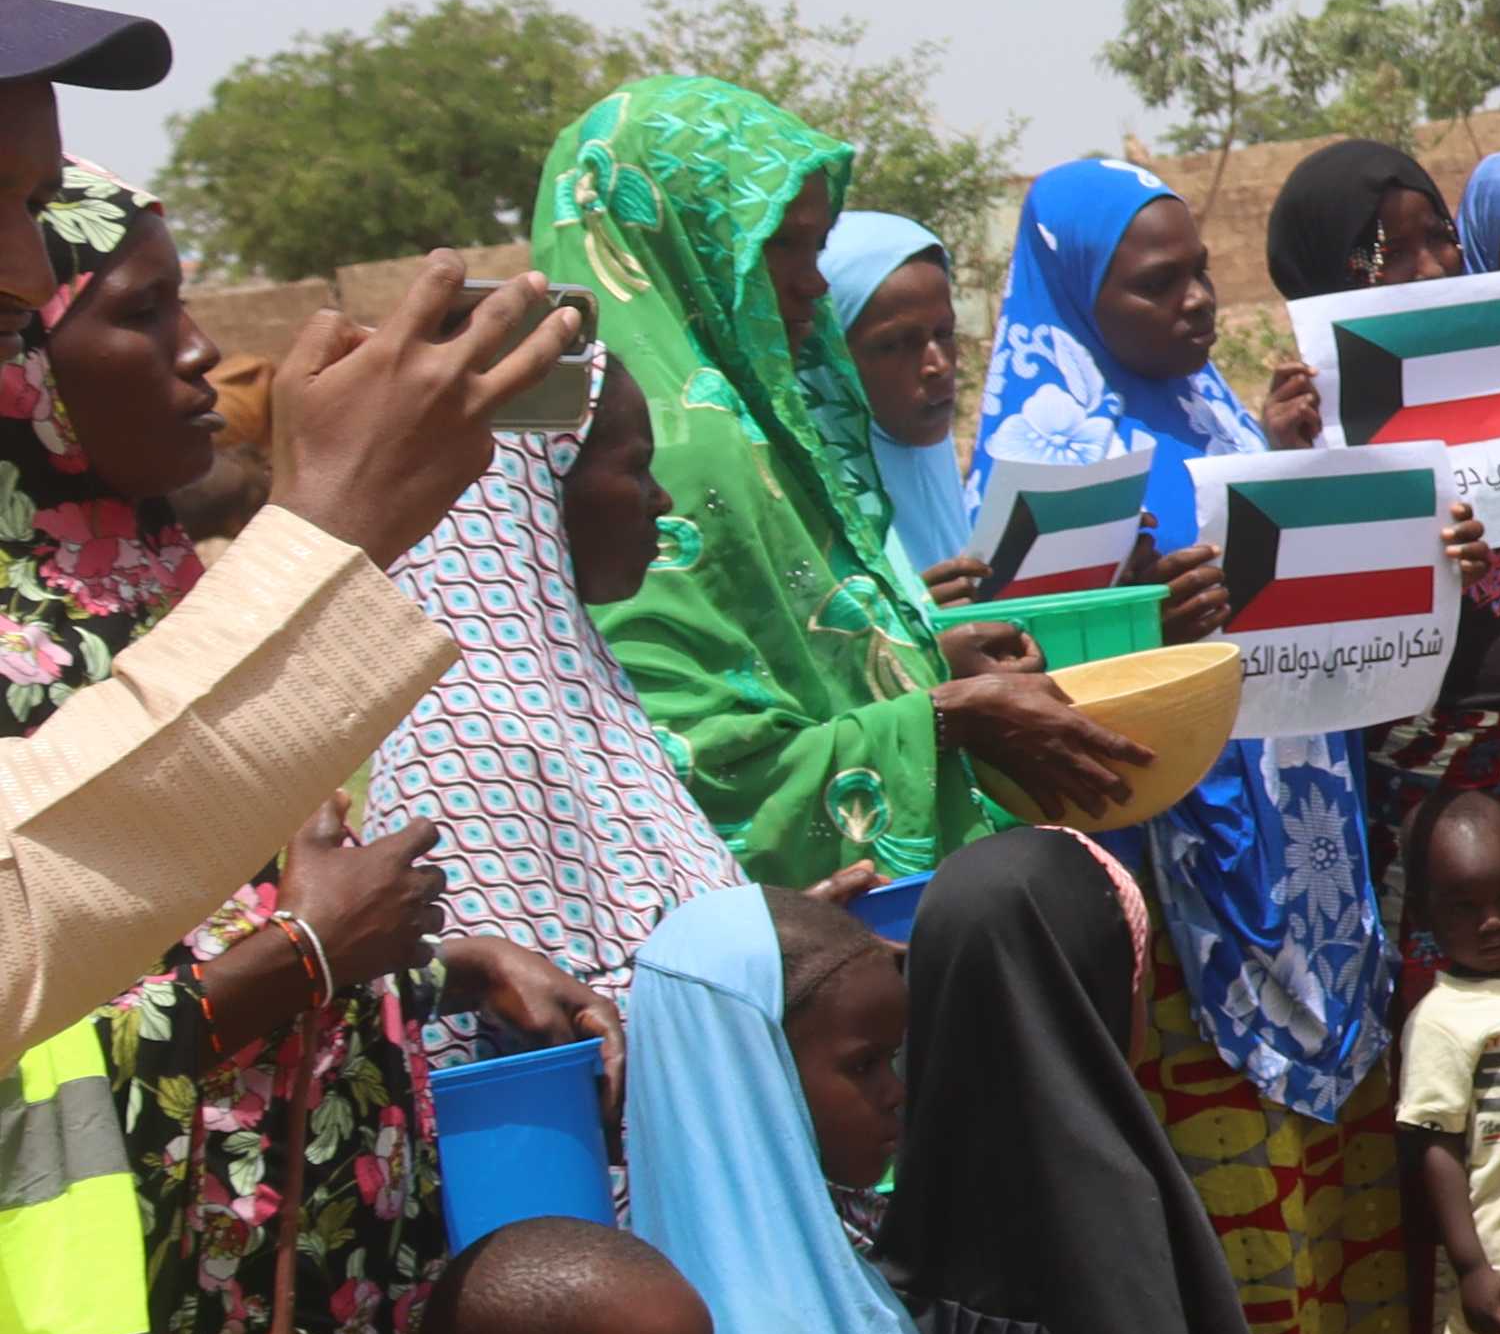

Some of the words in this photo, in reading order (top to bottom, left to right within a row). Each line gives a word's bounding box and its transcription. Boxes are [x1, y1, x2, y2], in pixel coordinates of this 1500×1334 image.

[1278, 642, 1319, 679] دولة
[1323, 639, 1395, 679] متبرعي
[1400, 628, 1444, 668] شكرا
